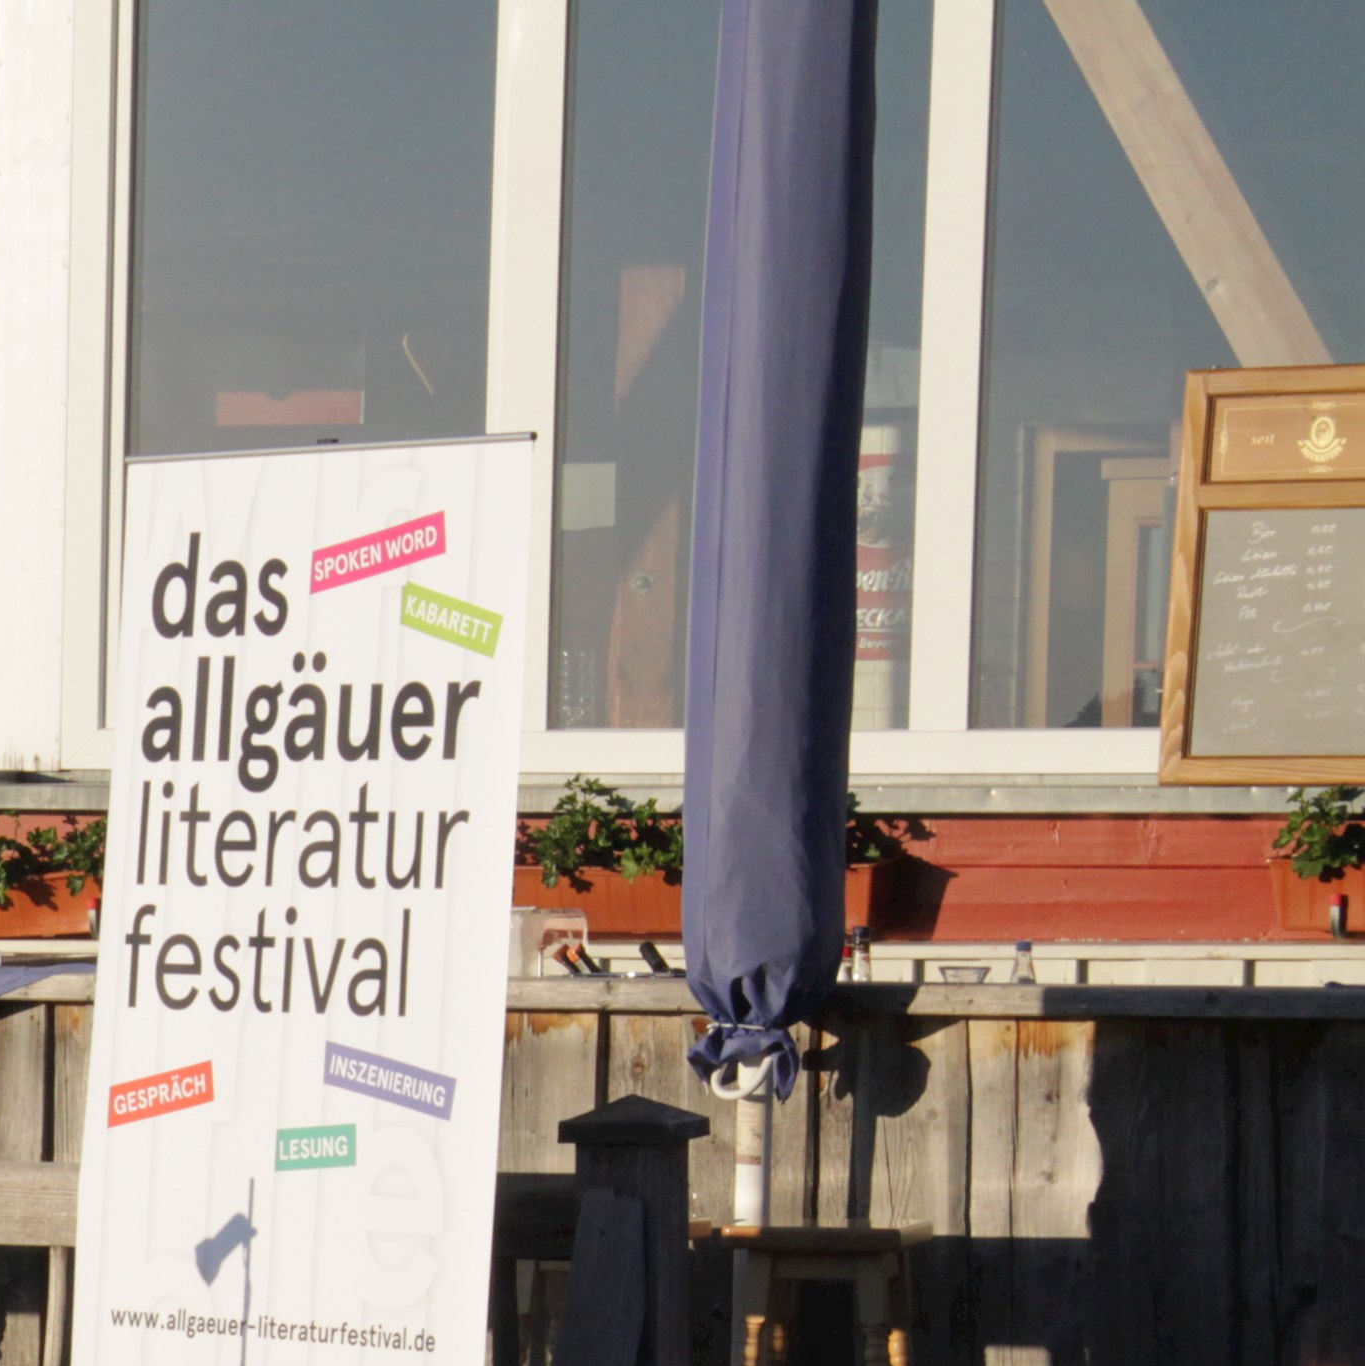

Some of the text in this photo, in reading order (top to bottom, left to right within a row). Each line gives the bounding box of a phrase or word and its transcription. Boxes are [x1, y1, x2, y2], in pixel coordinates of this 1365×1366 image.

[314, 525, 437, 581] SPOKEN WORD
[151, 532, 289, 639] das
[405, 595, 493, 643] KABARETT
[141, 651, 482, 793] allgäuer
[136, 780, 470, 890] literatur
[125, 904, 411, 1017] festival
[114, 1073, 206, 1115] GESPRÄCH
[329, 1054, 446, 1108] INSZENIERUNG
[279, 1135, 348, 1161] LESUNG
[111, 1308, 436, 1353] www.allgaeuer-literaturfestival.de
